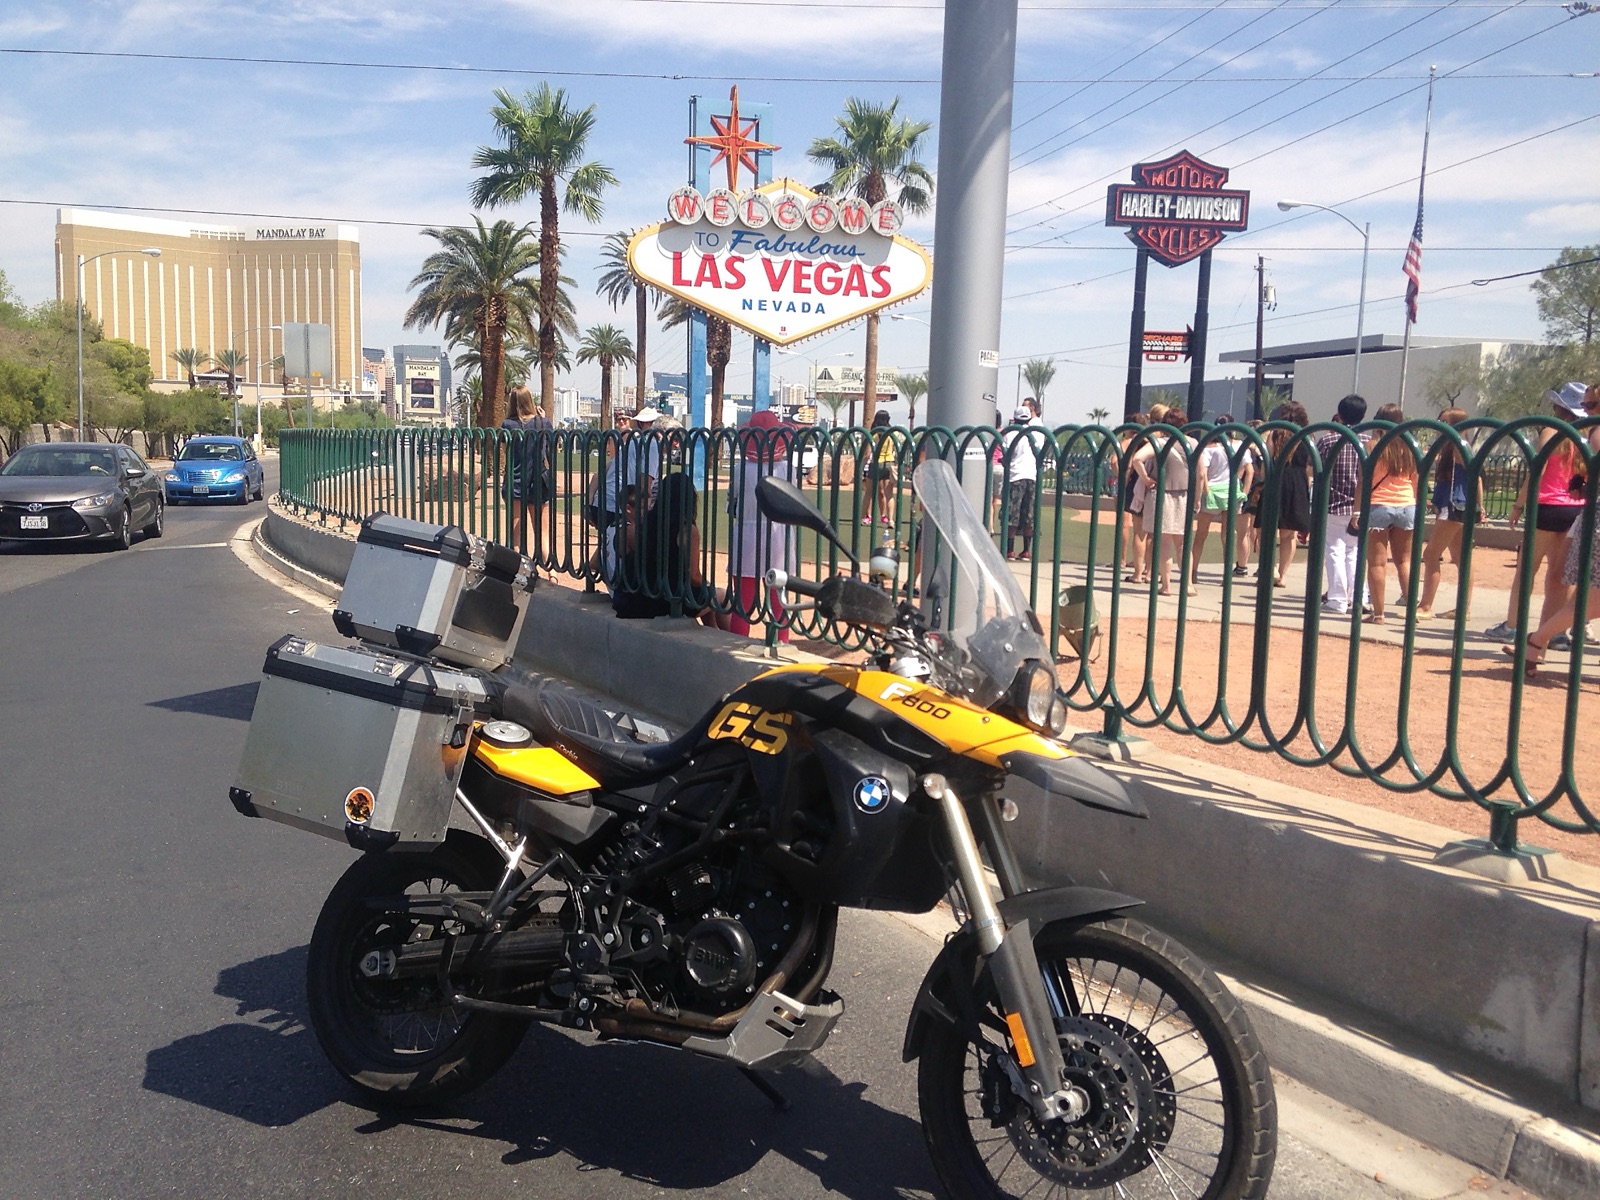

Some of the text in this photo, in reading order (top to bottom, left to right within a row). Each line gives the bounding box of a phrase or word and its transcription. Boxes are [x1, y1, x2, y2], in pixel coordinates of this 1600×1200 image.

[1151, 164, 1215, 189] MOTOR
[673, 192, 896, 231] WELCOME
[1121, 193, 1242, 221] HARLEY-DAVIDSON
[256, 228, 326, 239] MANDALAY BAY
[695, 229, 866, 257] TO Fabulous
[1147, 227, 1211, 256] CYCLES
[672, 251, 892, 299] LAS VEGAS
[742, 299, 826, 314] NEVADA
[706, 701, 793, 755] GS
